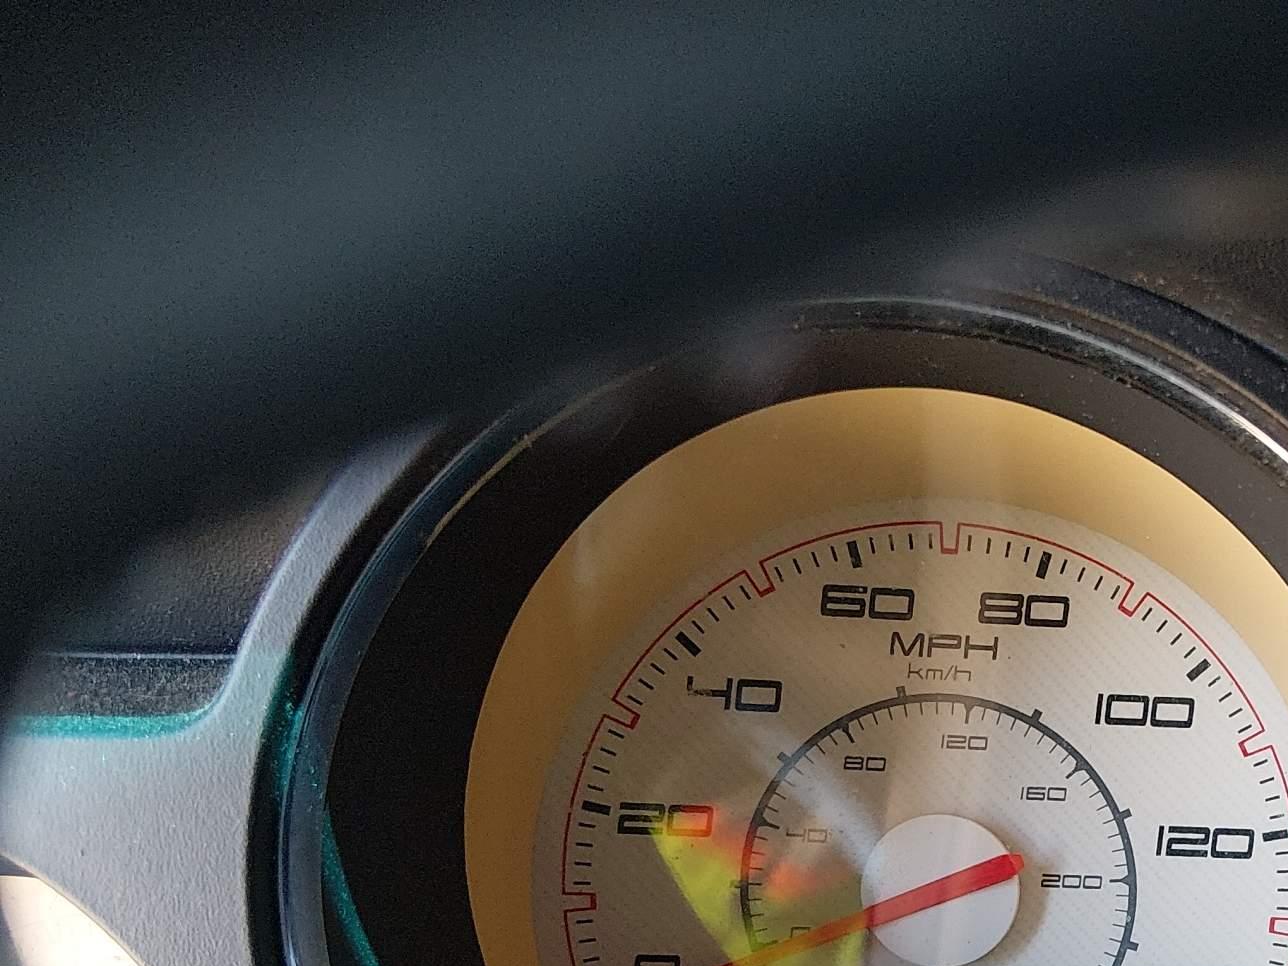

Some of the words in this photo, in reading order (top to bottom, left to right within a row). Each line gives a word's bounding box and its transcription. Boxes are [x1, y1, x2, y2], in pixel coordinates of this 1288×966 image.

[820, 584, 915, 621] 60
[978, 593, 1070, 628] 80
[889, 631, 998, 660] MPH
[907, 663, 972, 682] km/h
[686, 676, 783, 712] 40
[1094, 693, 1195, 728] 100
[941, 734, 988, 750] 120
[843, 755, 886, 771] 80
[1021, 786, 1067, 801] 160
[617, 802, 713, 837] 20
[785, 827, 828, 843] 40
[1156, 825, 1254, 859] 120
[1041, 873, 1102, 889] 200
